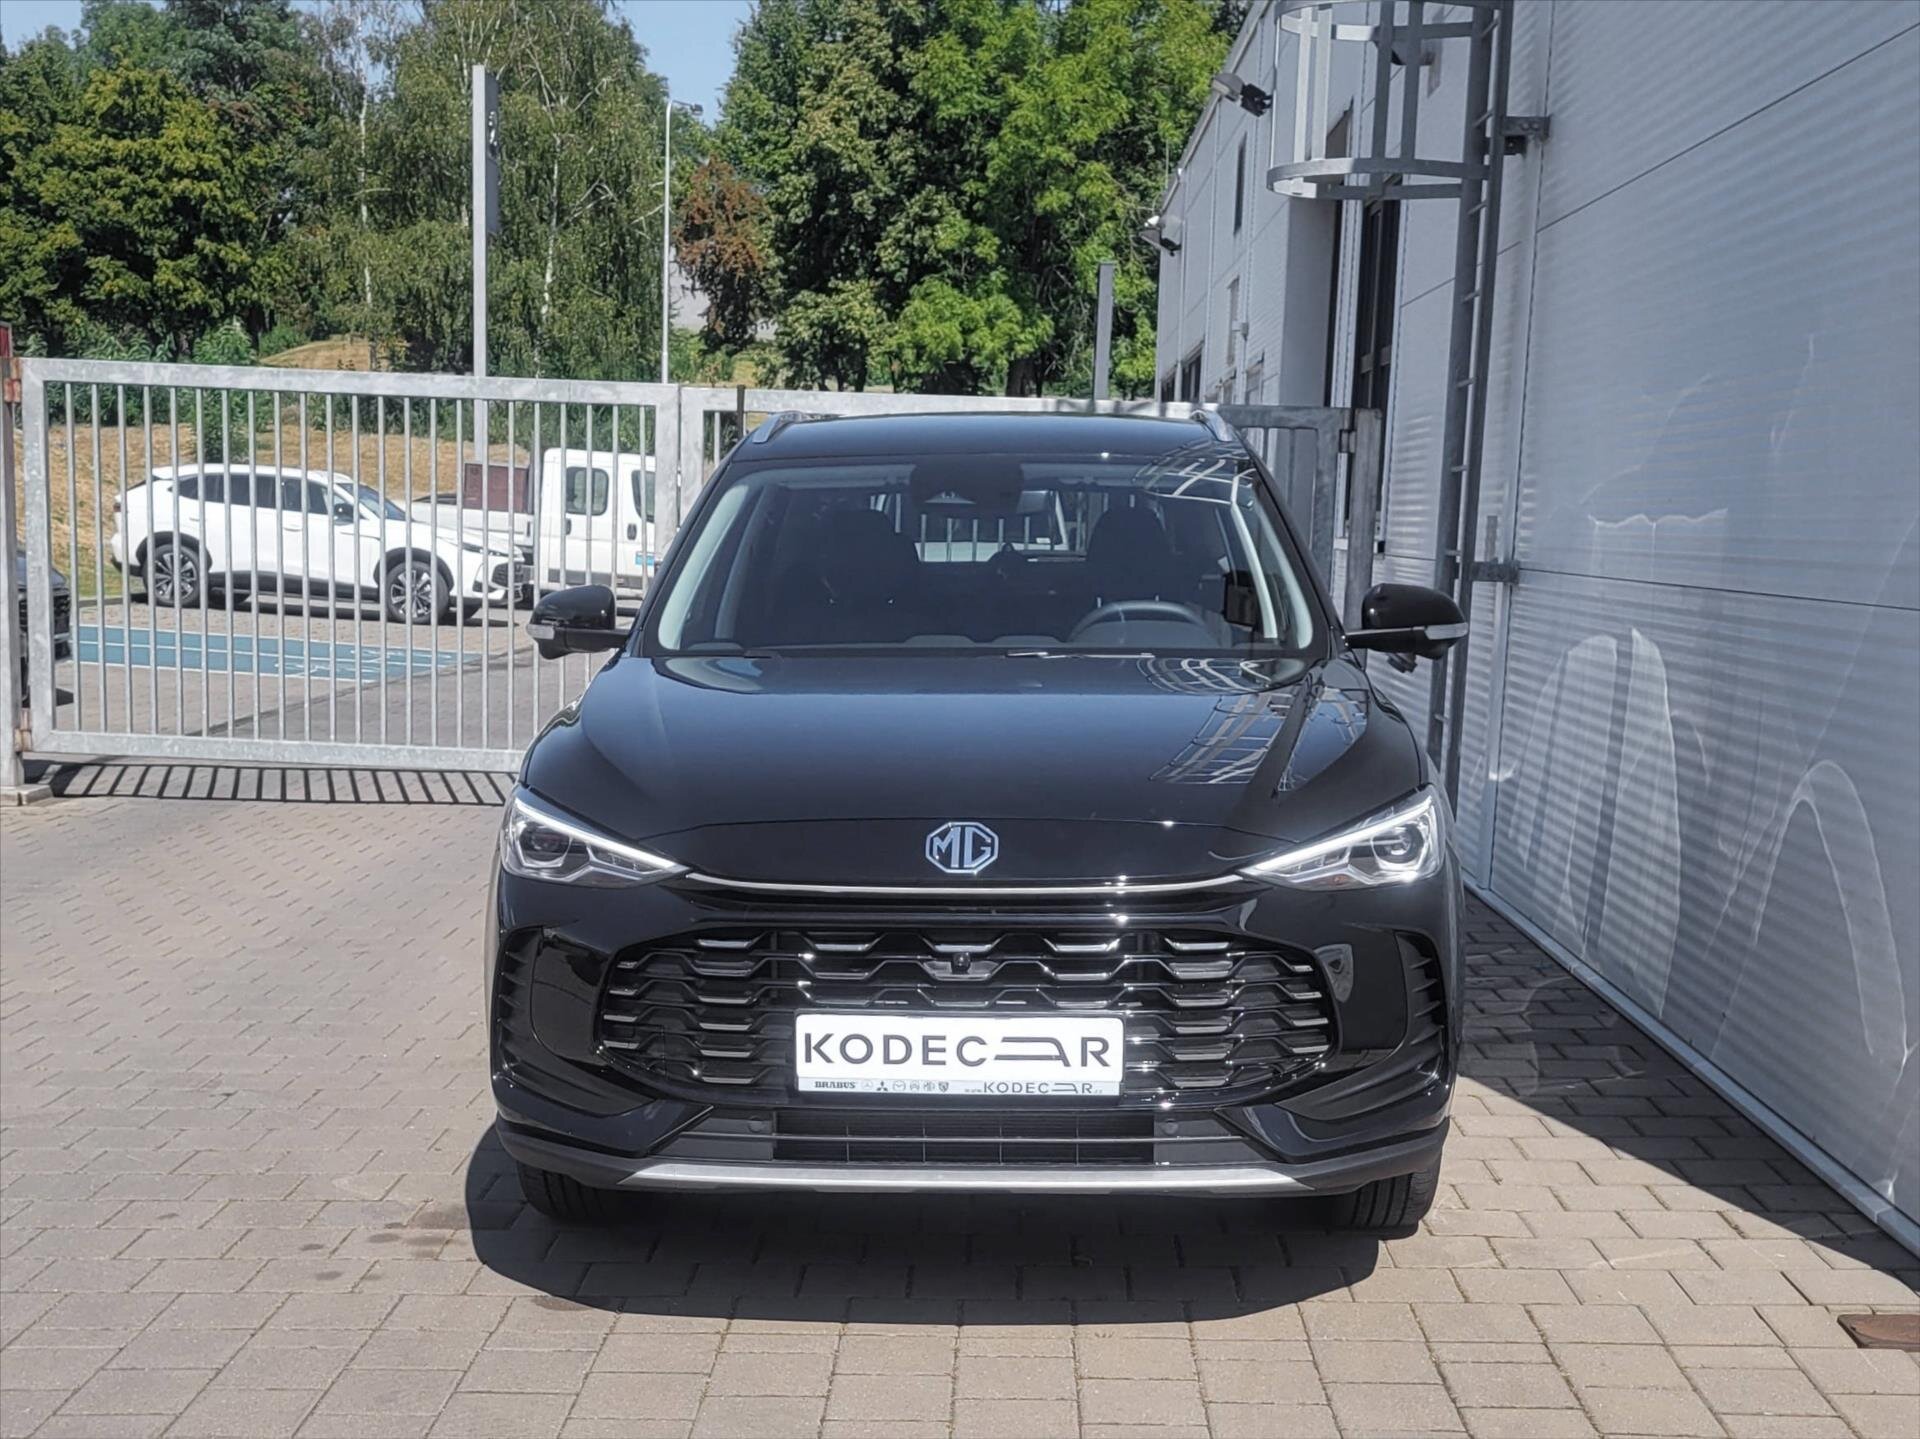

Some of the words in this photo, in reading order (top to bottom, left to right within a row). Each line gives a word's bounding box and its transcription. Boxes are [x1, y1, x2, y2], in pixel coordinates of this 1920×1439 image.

[932, 826, 992, 868] MG
[804, 1032, 1110, 1067] KODECAR
[814, 1080, 856, 1090] BRABUS
